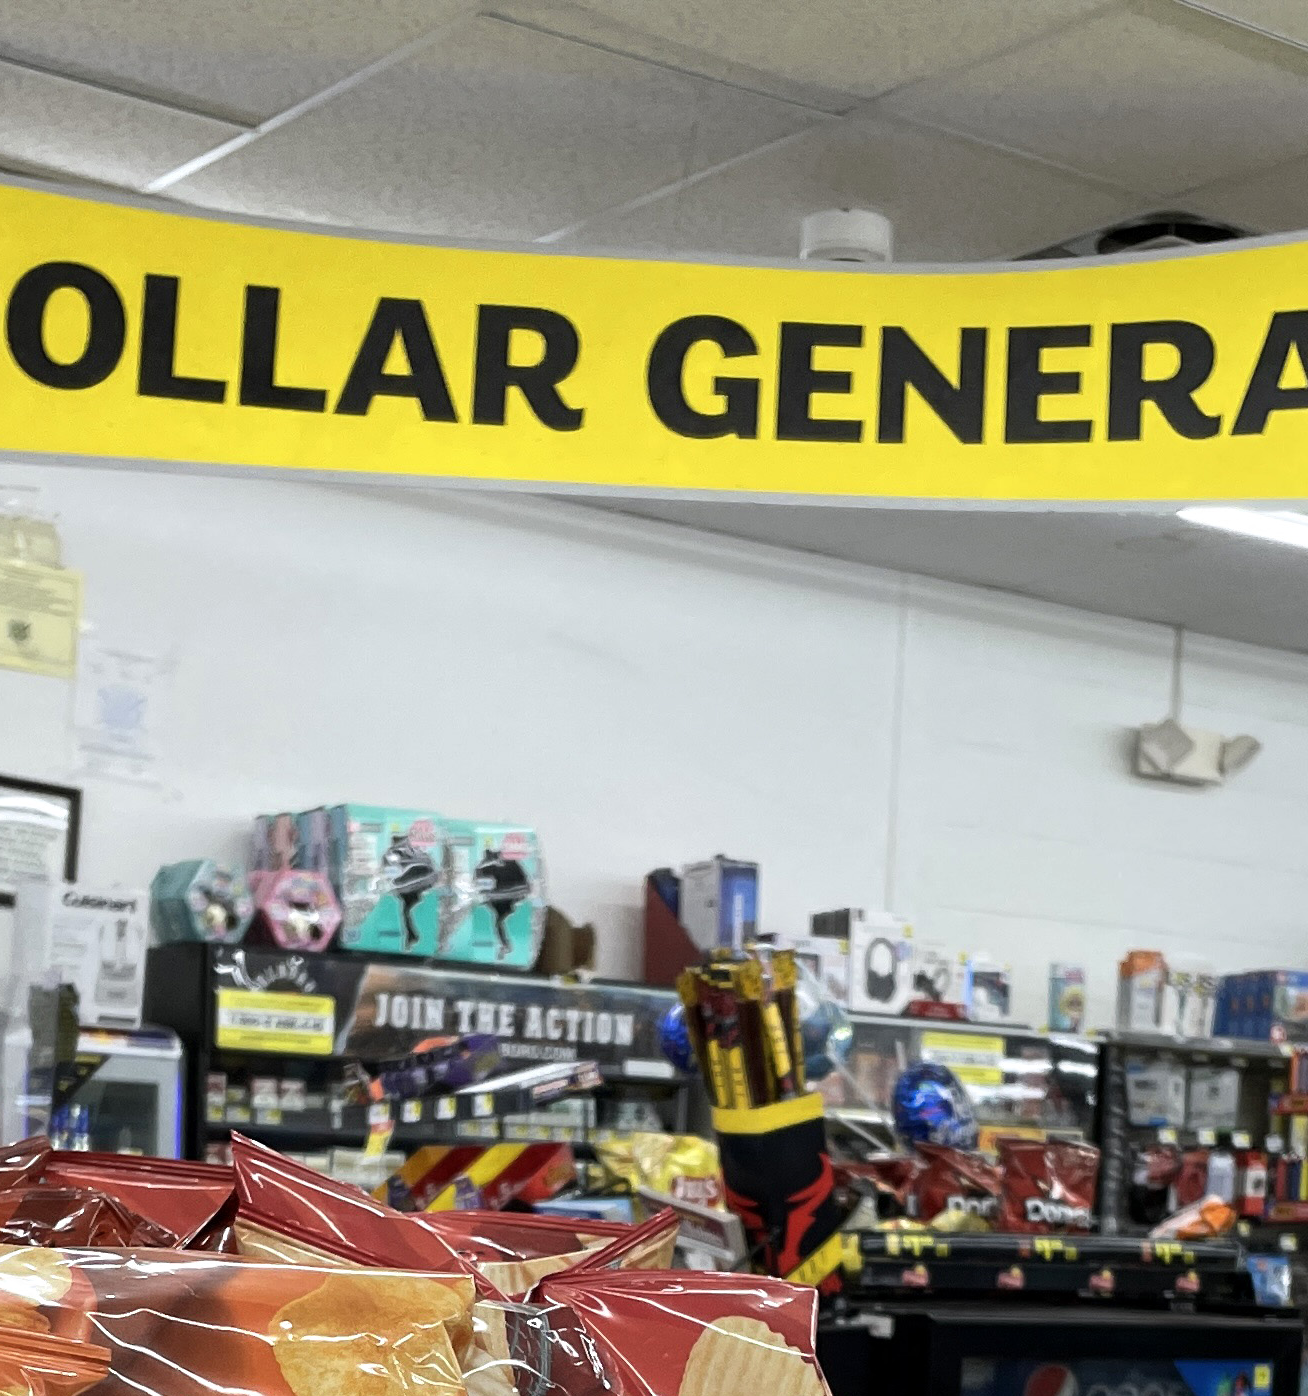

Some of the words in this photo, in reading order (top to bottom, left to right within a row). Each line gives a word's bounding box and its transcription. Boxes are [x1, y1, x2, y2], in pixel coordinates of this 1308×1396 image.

[374, 993, 444, 1031] JOIN
[454, 1001, 514, 1038] THE
[522, 1006, 634, 1045] ACTION
